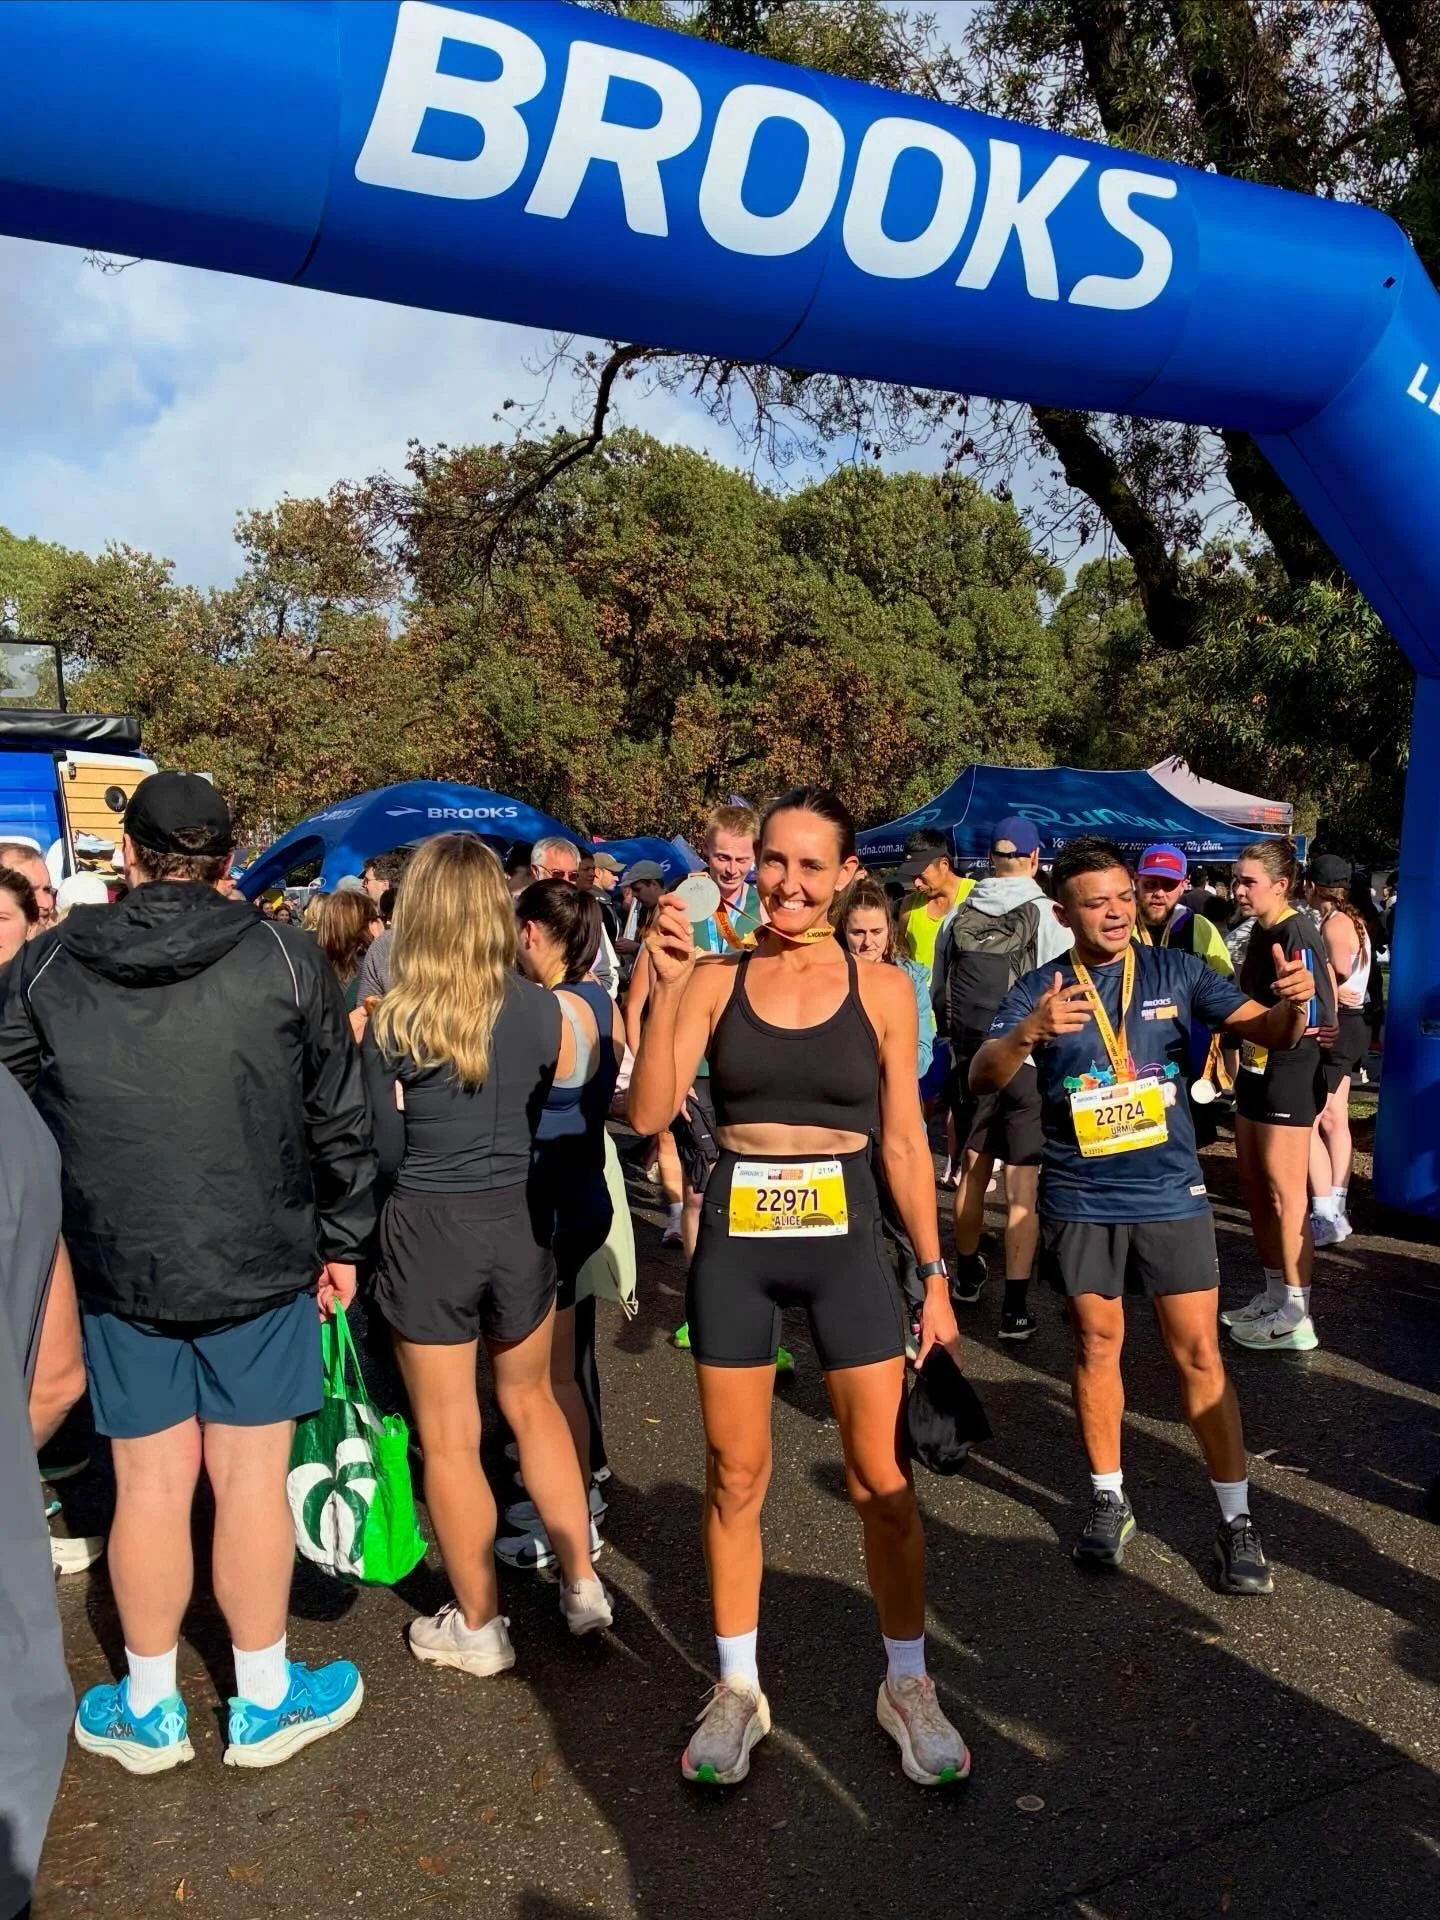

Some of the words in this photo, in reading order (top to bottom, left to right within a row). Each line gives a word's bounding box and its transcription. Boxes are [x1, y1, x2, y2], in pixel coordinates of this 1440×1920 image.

[355, 1, 1177, 311] BROOKS
[428, 806, 518, 819] BROOKS
[1095, 1101, 1145, 1126] 22724
[756, 1189, 818, 1212] 22971
[774, 1215, 801, 1226] ALICE
[277, 1706, 317, 1727] HOKA
[104, 1721, 136, 1739] HOKA
